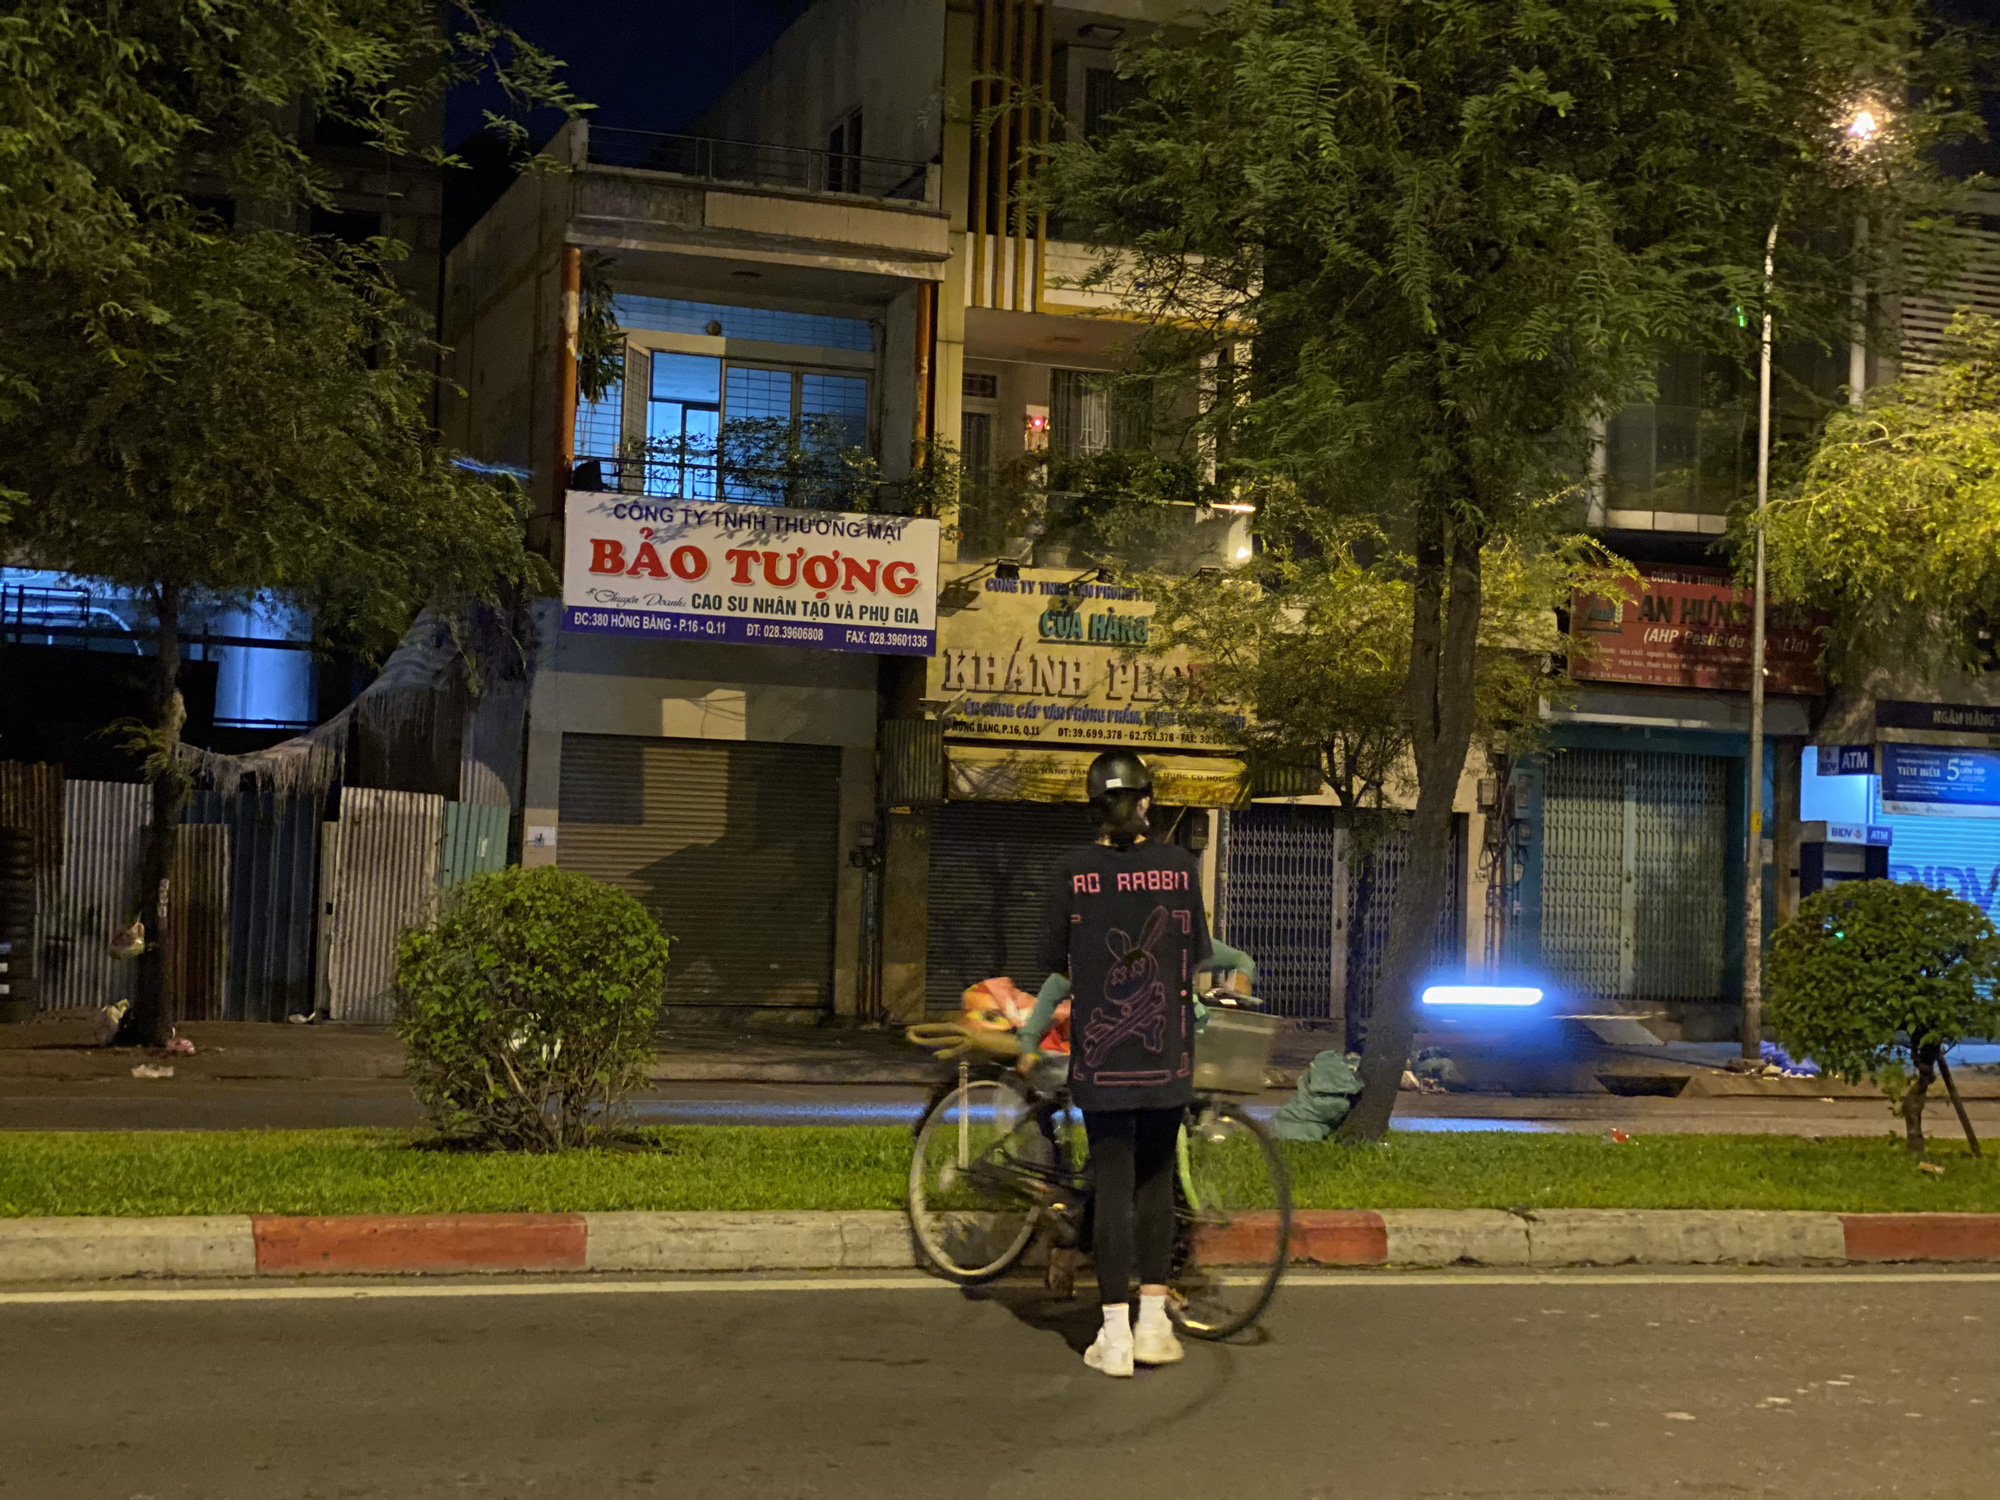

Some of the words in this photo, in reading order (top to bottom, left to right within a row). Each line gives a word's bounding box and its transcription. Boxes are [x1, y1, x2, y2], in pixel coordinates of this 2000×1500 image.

[613, 500, 674, 523] CÔNG
[680, 508, 707, 526] TY
[711, 511, 766, 532] TNHH
[772, 515, 861, 538] THƯƠNG
[866, 523, 901, 544] MẠI
[588, 526, 708, 581] BẢO
[725, 546, 920, 600] TƯỢNG
[691, 593, 722, 609] CAO
[727, 596, 748, 612] SU
[753, 596, 797, 615] NHÂN
[801, 601, 830, 621] TẠO
[835, 601, 854, 620] VÀ
[859, 605, 889, 625] PHỤ
[894, 607, 919, 624] GIA
[1637, 594, 1673, 623] AN
[679, 619, 698, 632] P.16
[705, 621, 726, 634] Q.11
[747, 623, 761, 637] ĐT:
[763, 625, 823, 641] 028.39606808
[1088, 606, 1149, 643] HÀNG
[1643, 627, 1680, 645] (AHP
[846, 630, 867, 643] FAX:
[869, 632, 928, 648] 028.39601336
[941, 637, 1090, 697] KHÁNH
[1842, 752, 1868, 769] ATM
[1946, 758, 1960, 781] 5
[1832, 828, 1853, 838] BIDV
[1870, 830, 1889, 841] ATM
